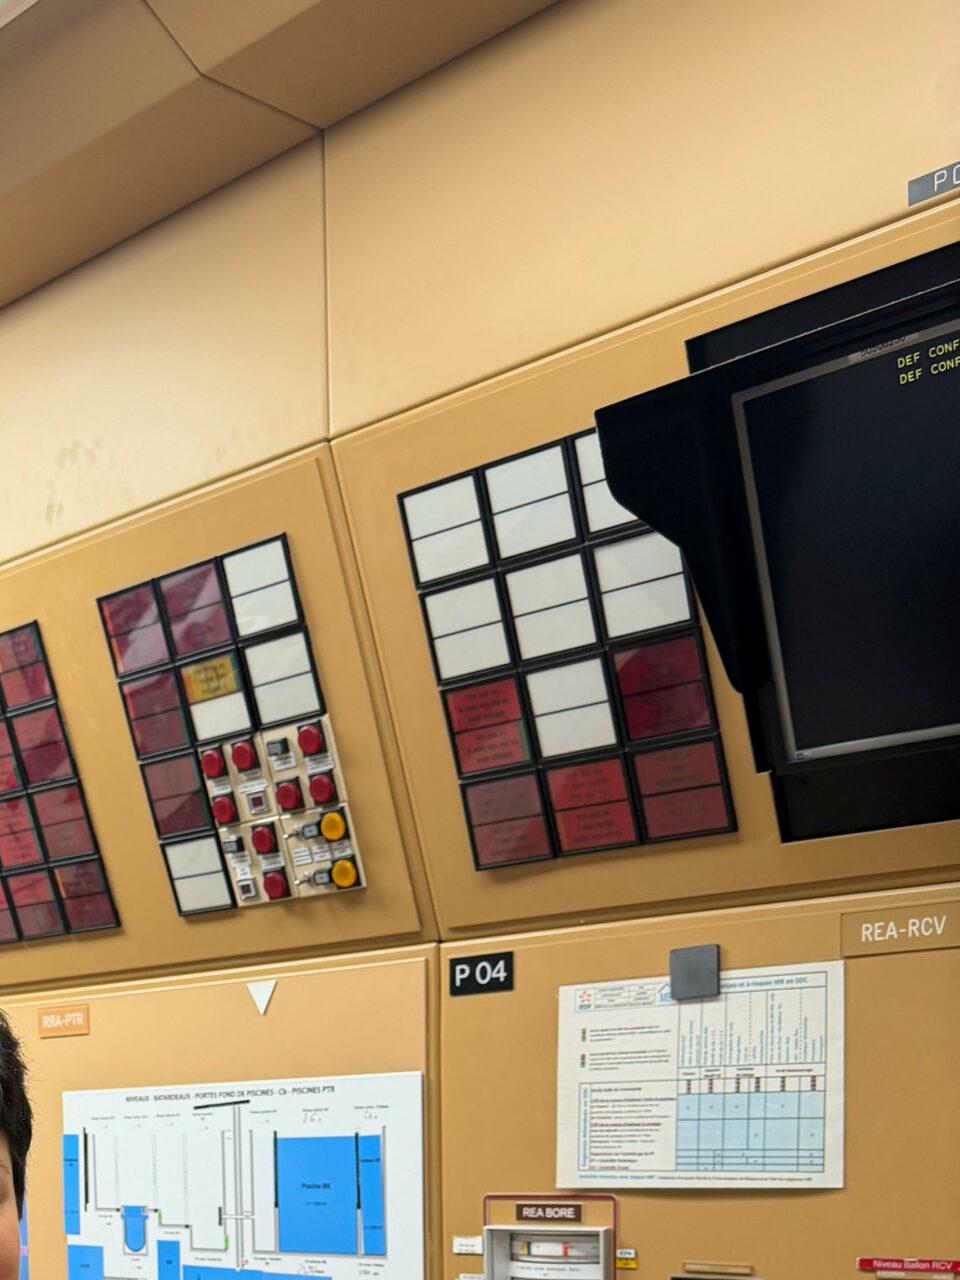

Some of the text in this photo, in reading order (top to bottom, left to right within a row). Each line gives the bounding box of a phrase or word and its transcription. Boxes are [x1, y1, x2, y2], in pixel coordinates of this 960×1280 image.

[897, 352, 920, 369] DEF
[928, 339, 960, 358] CONF
[900, 368, 922, 385] DEF
[861, 915, 947, 942] REA-RCV
[455, 960, 507, 987] P 04
[522, 1207, 575, 1219] REA BORE
[872, 1260, 902, 1269] Niveau
[932, 1261, 953, 1270] RCV
